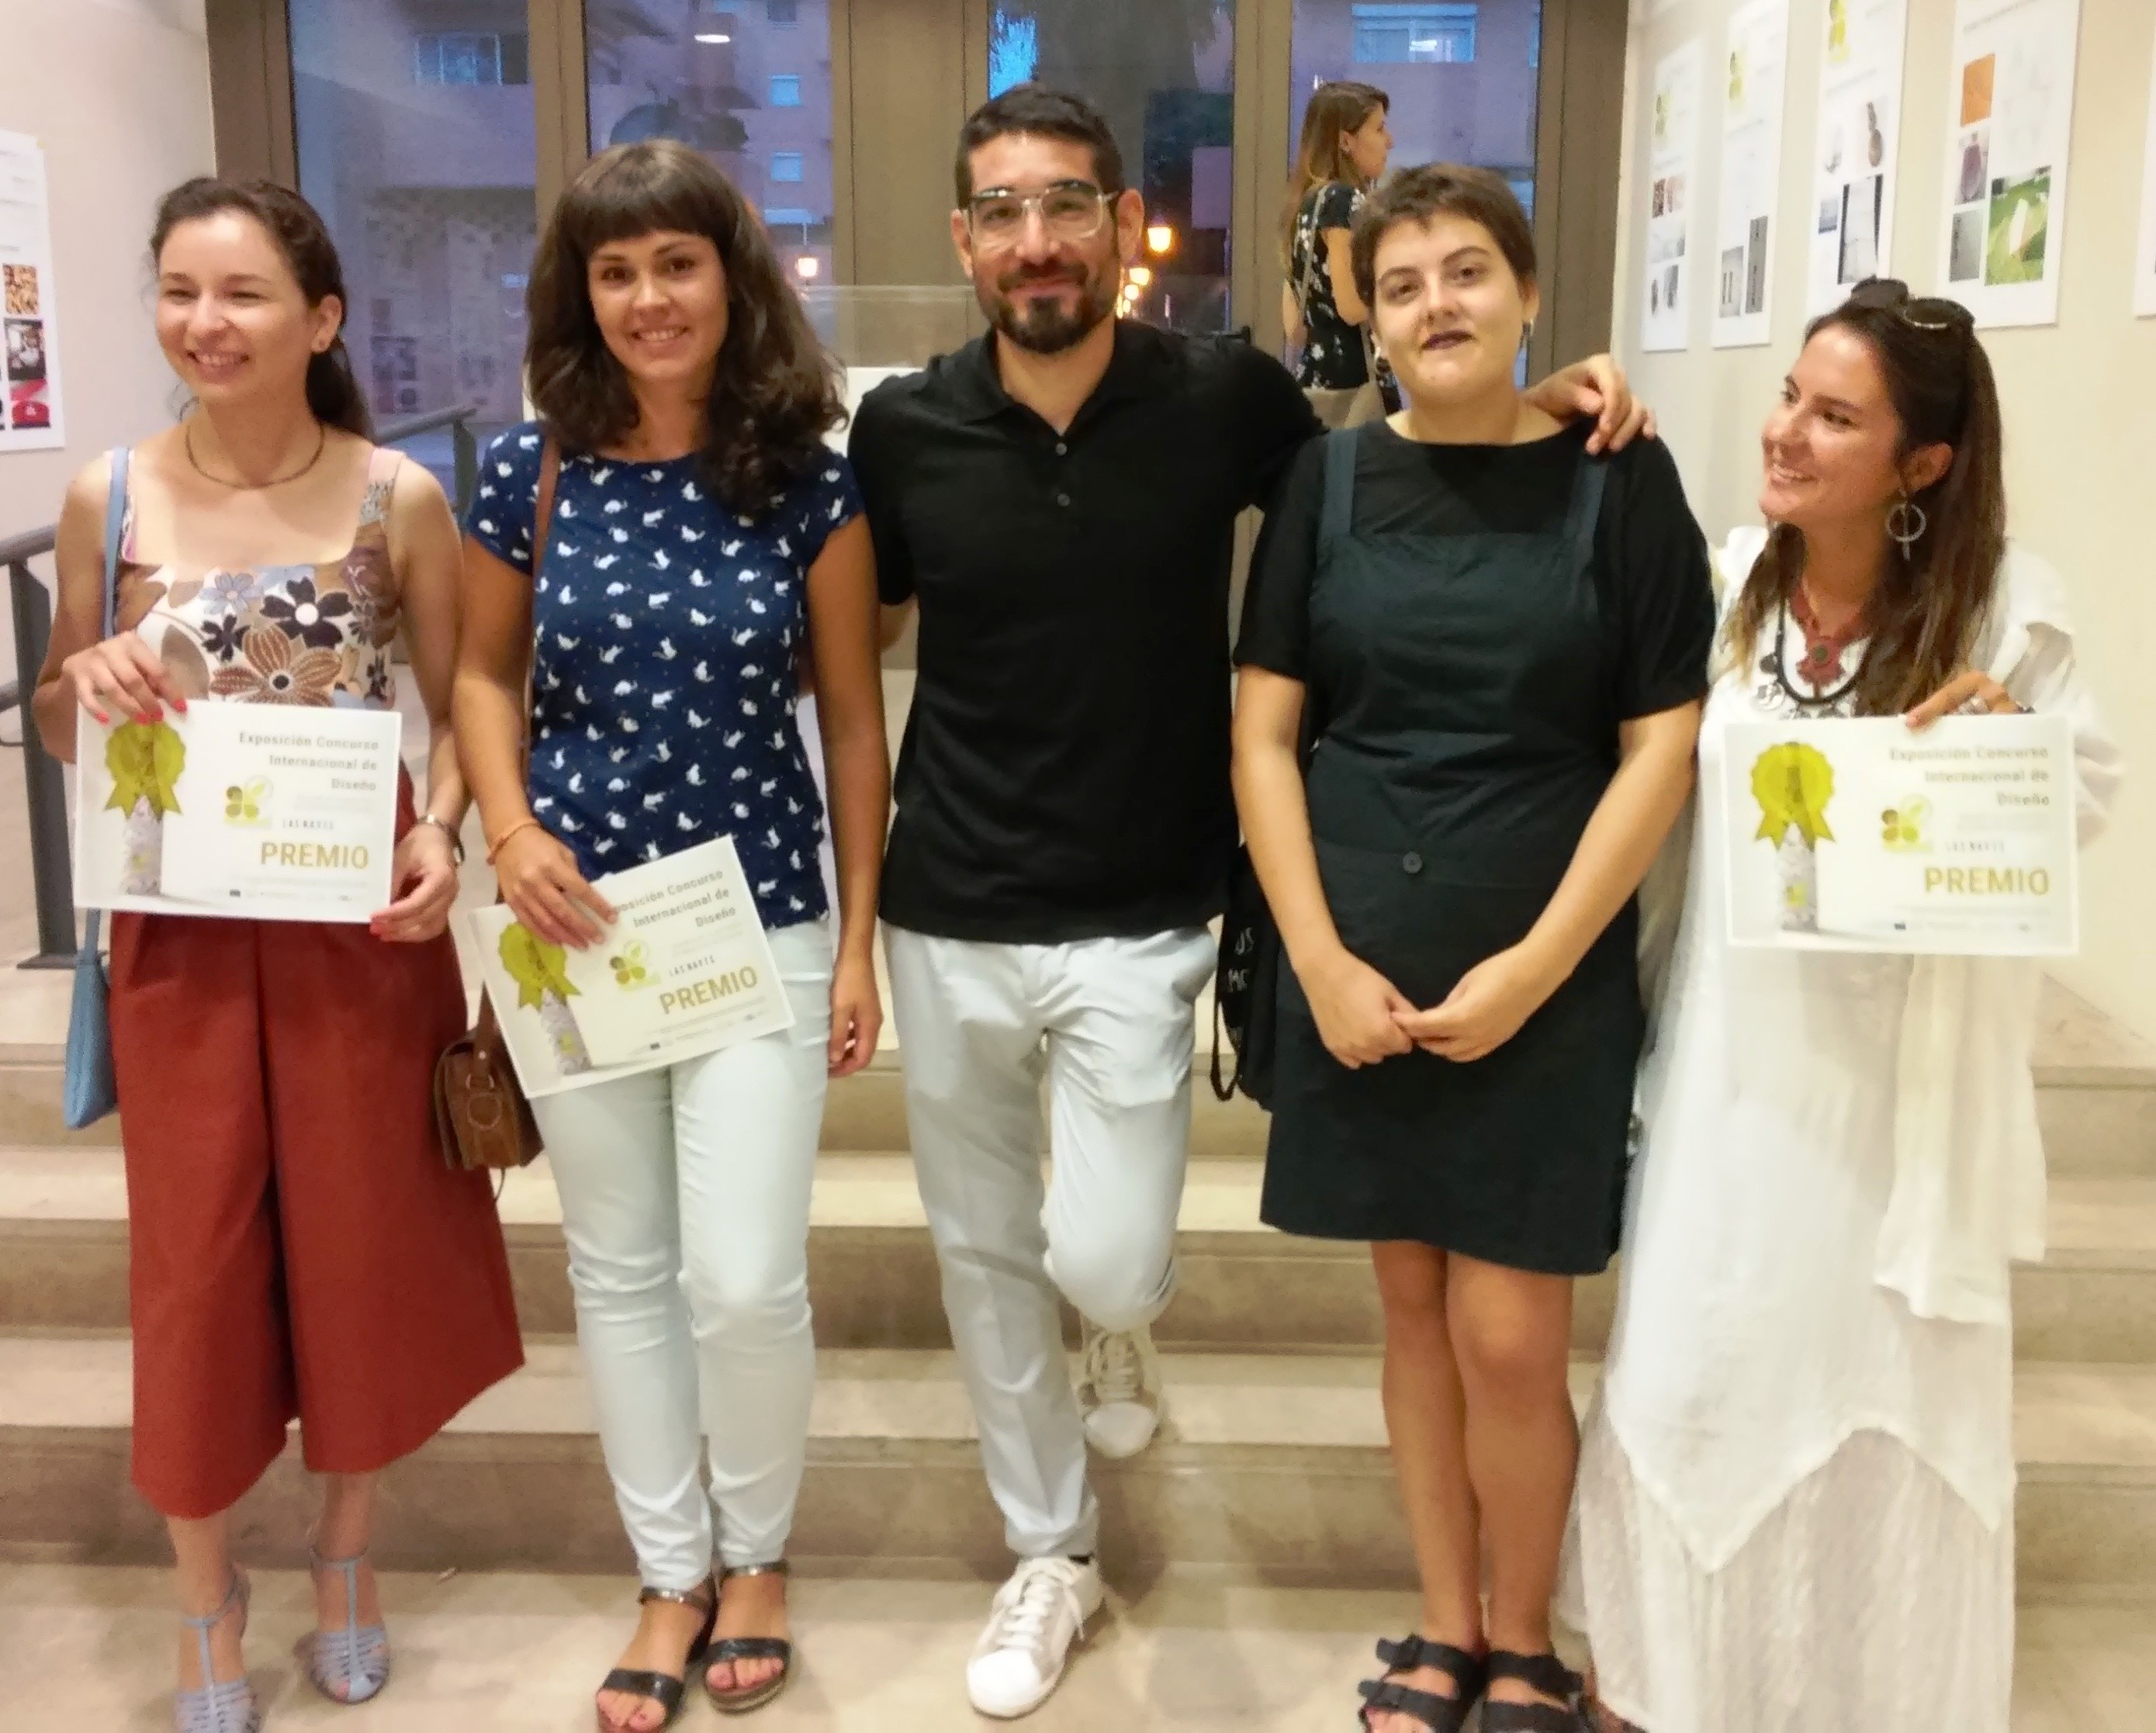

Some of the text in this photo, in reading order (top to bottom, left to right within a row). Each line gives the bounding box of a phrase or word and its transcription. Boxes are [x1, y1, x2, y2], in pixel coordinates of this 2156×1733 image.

[317, 735, 379, 751] Concurso
[269, 754, 378, 770] Internacional de
[261, 841, 370, 870] PREMIO
[667, 870, 724, 896] Concurso
[1925, 866, 2050, 896] PREMIO
[633, 887, 730, 928] Internacional de
[695, 905, 736, 927] Diseño
[658, 964, 758, 1015] PREMIO
